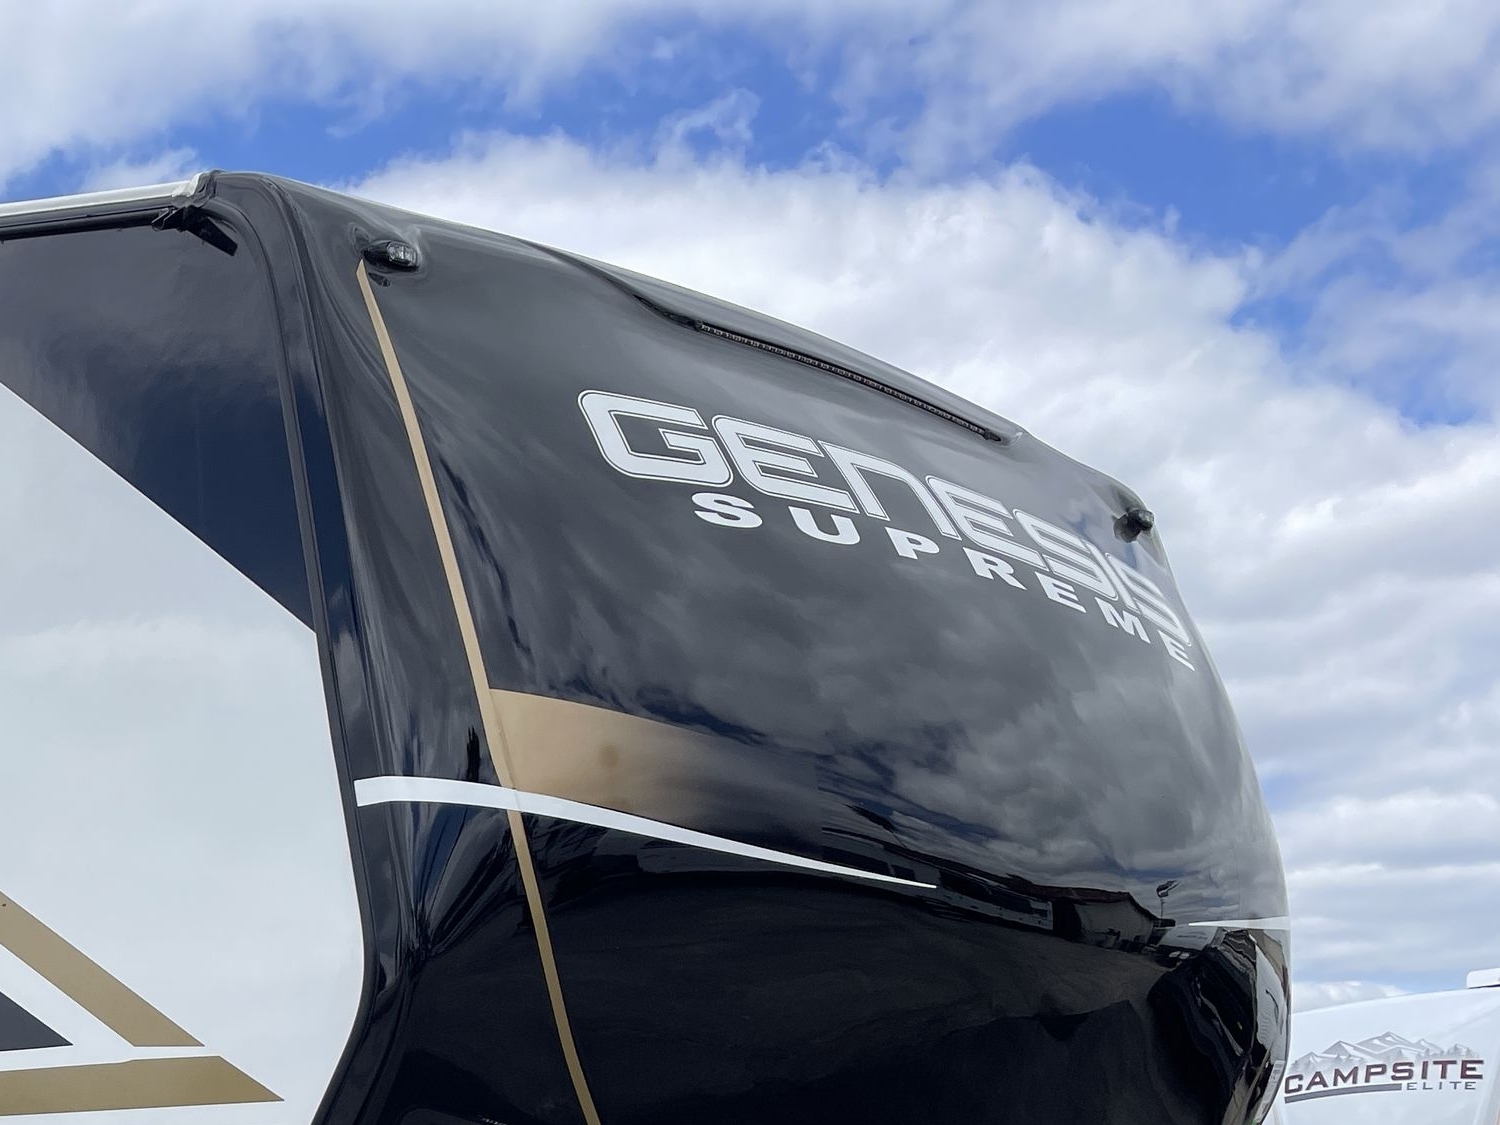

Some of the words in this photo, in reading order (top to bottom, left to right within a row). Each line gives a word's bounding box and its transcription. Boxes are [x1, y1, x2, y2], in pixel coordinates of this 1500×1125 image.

[578, 389, 1192, 647] GENESIS
[691, 492, 1196, 672] SUPREME
[1284, 1059, 1484, 1094] CAMPSITE
[1406, 1081, 1477, 1091] ELITE
